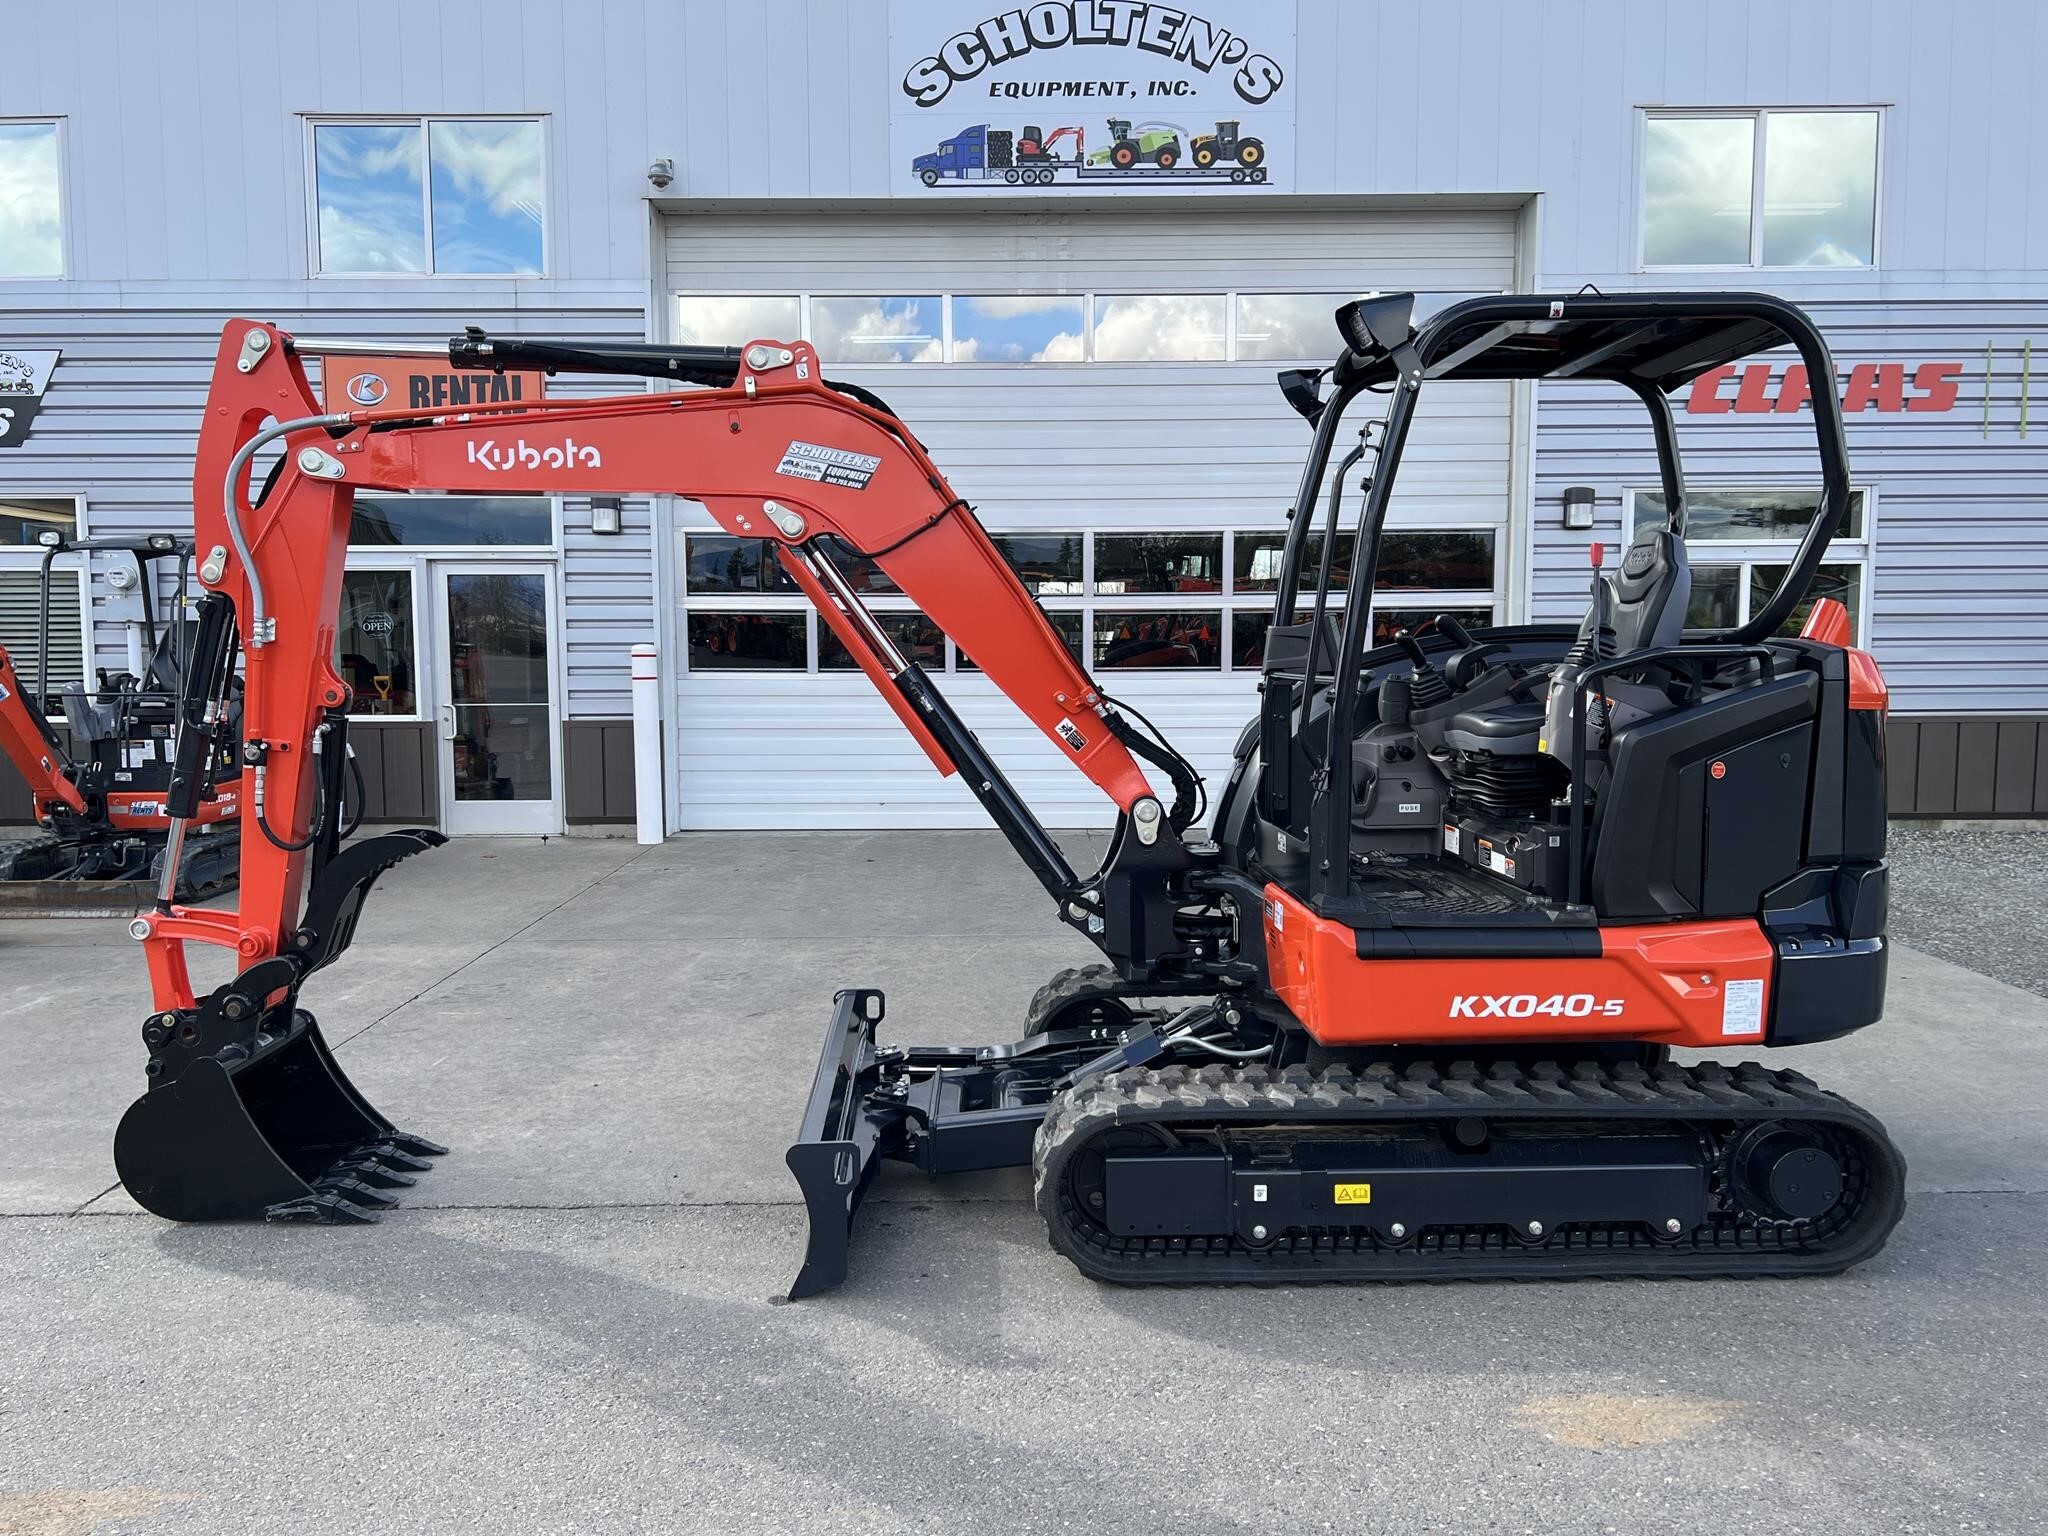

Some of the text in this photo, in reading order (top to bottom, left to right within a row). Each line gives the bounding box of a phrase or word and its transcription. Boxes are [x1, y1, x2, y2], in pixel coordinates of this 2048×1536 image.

[903, 0, 1284, 107] SCHOLTEN'S
[989, 80, 1197, 99] EQUIPMENT, INC.
[409, 374, 528, 415] RENTAL
[467, 438, 601, 471] Kubota
[790, 444, 876, 469] SCHOLTEN'S
[826, 465, 871, 482] EQUIPMENT
[363, 622, 391, 631] OPEN
[1448, 994, 1625, 1018] KX040-5
